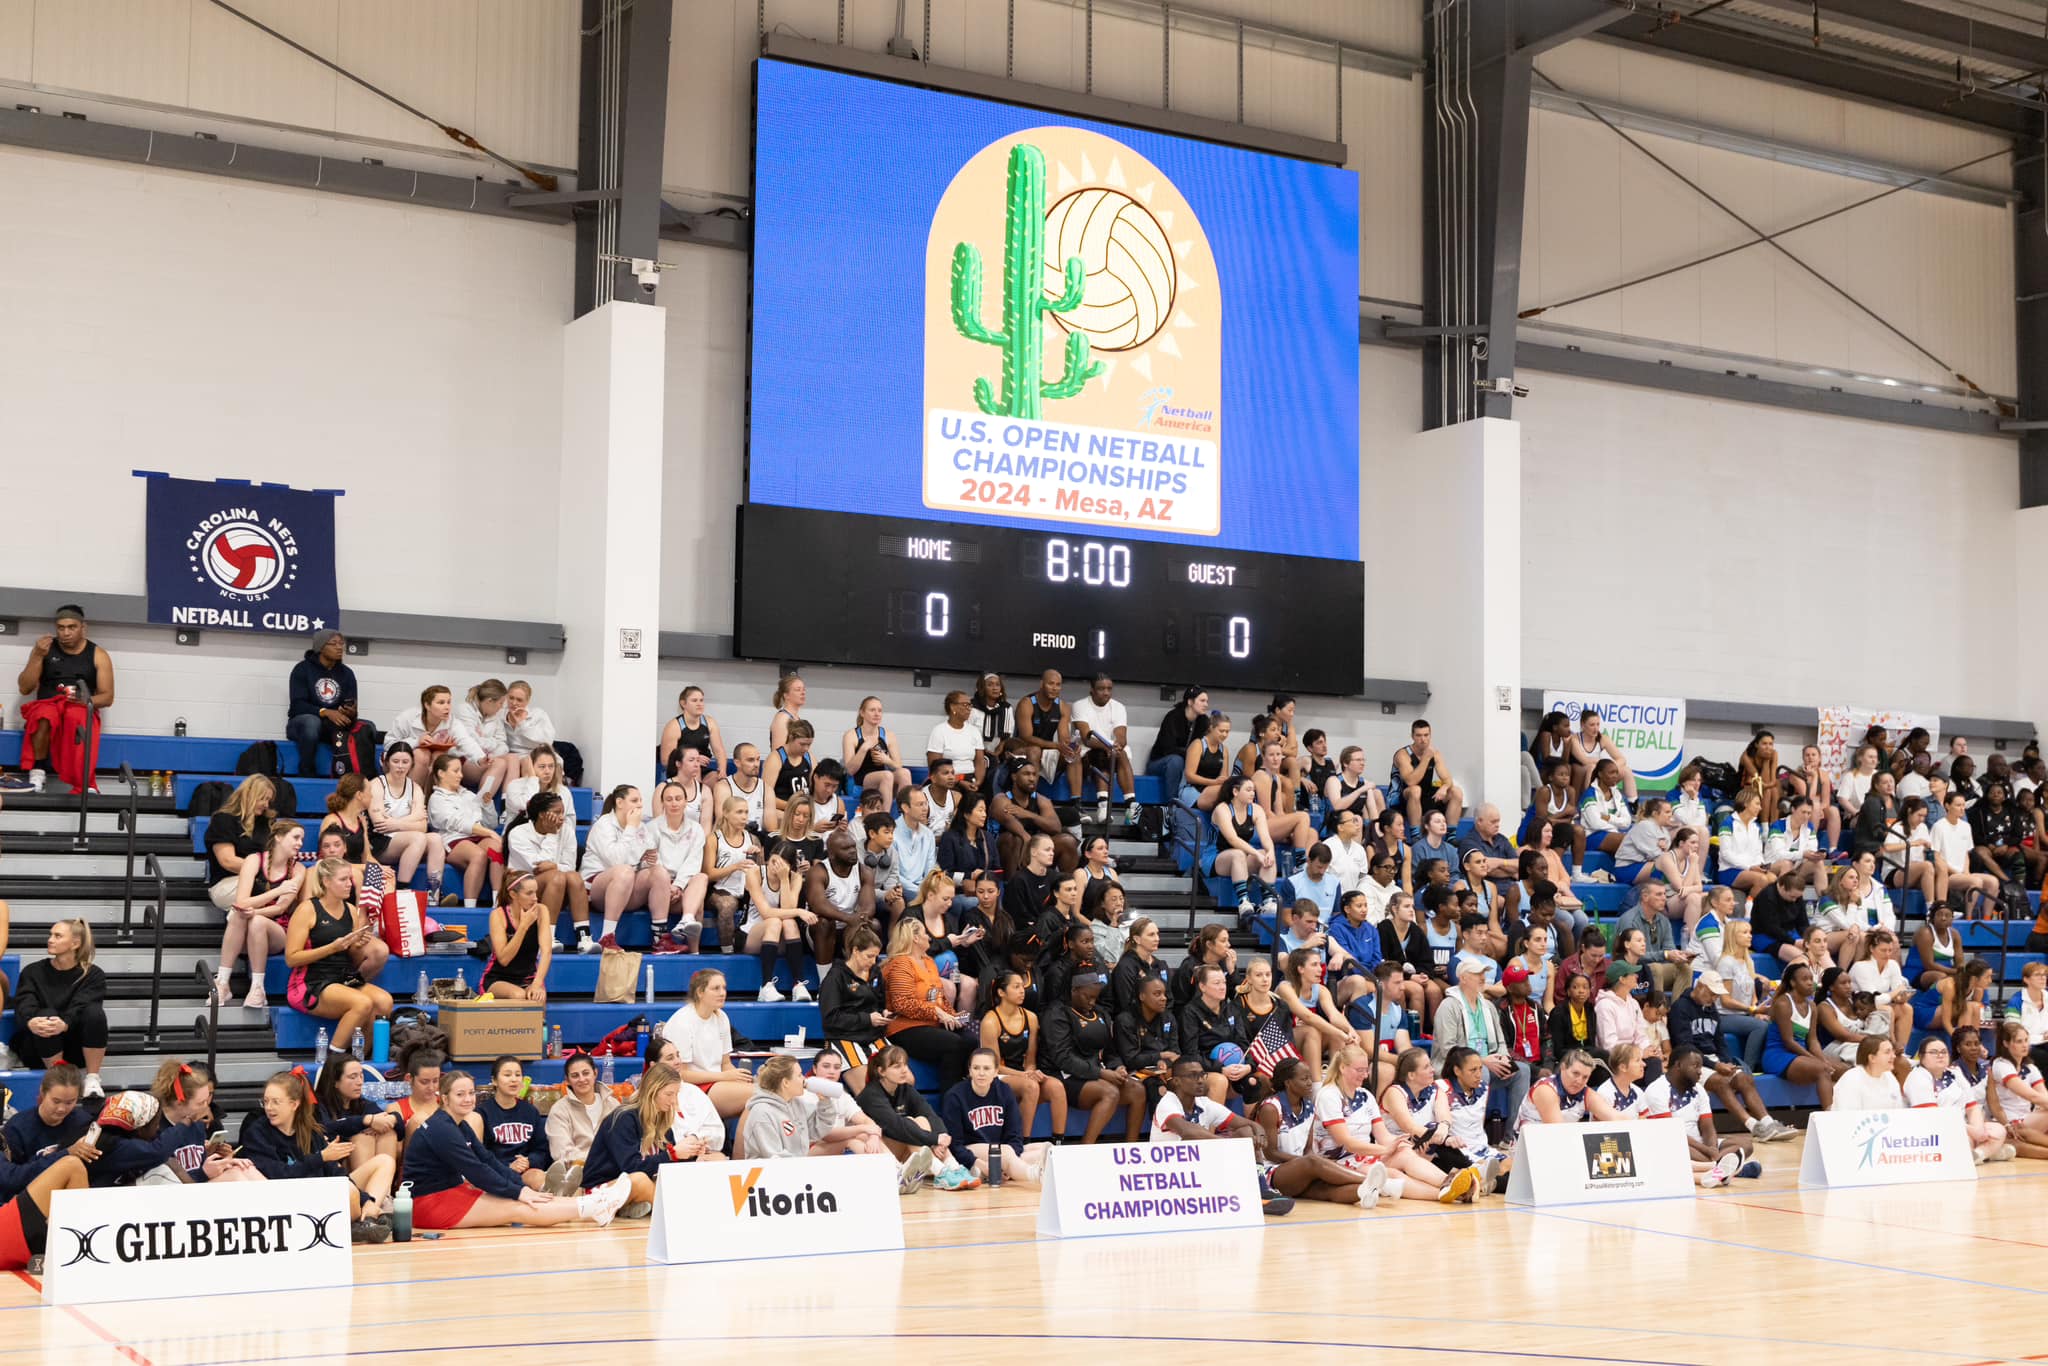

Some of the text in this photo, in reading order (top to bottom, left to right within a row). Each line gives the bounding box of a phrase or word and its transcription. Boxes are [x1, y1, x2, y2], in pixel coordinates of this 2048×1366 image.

[1154, 416, 1212, 433] America
[1160, 404, 1213, 421] Netball
[941, 417, 1205, 468] U.S. OPEN NETBALL
[952, 448, 1188, 494] CHAMPIONSHIPS
[959, 478, 1031, 506] 2024
[1055, 488, 1130, 521] Mesa,
[1137, 498, 1174, 522] AZ
[186, 507, 299, 557] CAROLINA NETS
[907, 537, 952, 561] HOME
[1046, 539, 1131, 587] 8:00
[1188, 563, 1236, 586] GUEST
[246, 592, 270, 602] USA
[172, 606, 310, 631] NETBALL CLUB
[926, 593, 949, 637] 0
[1032, 630, 1105, 659] PERIOD 1
[1228, 617, 1250, 659] 0
[464, 1027, 536, 1036] PORT AUTHORITY
[968, 1105, 1004, 1130] MINC
[493, 1122, 533, 1144] MINC
[1881, 1134, 1940, 1149] Netball
[1113, 1145, 1200, 1165] U.S. OPEN
[1877, 1150, 1943, 1165] America
[728, 1167, 838, 1217] Vitoria
[1119, 1171, 1202, 1192] NETBALL
[1084, 1195, 1241, 1220] CHAMPIONSHIPS
[115, 1214, 293, 1263] GILBERT
